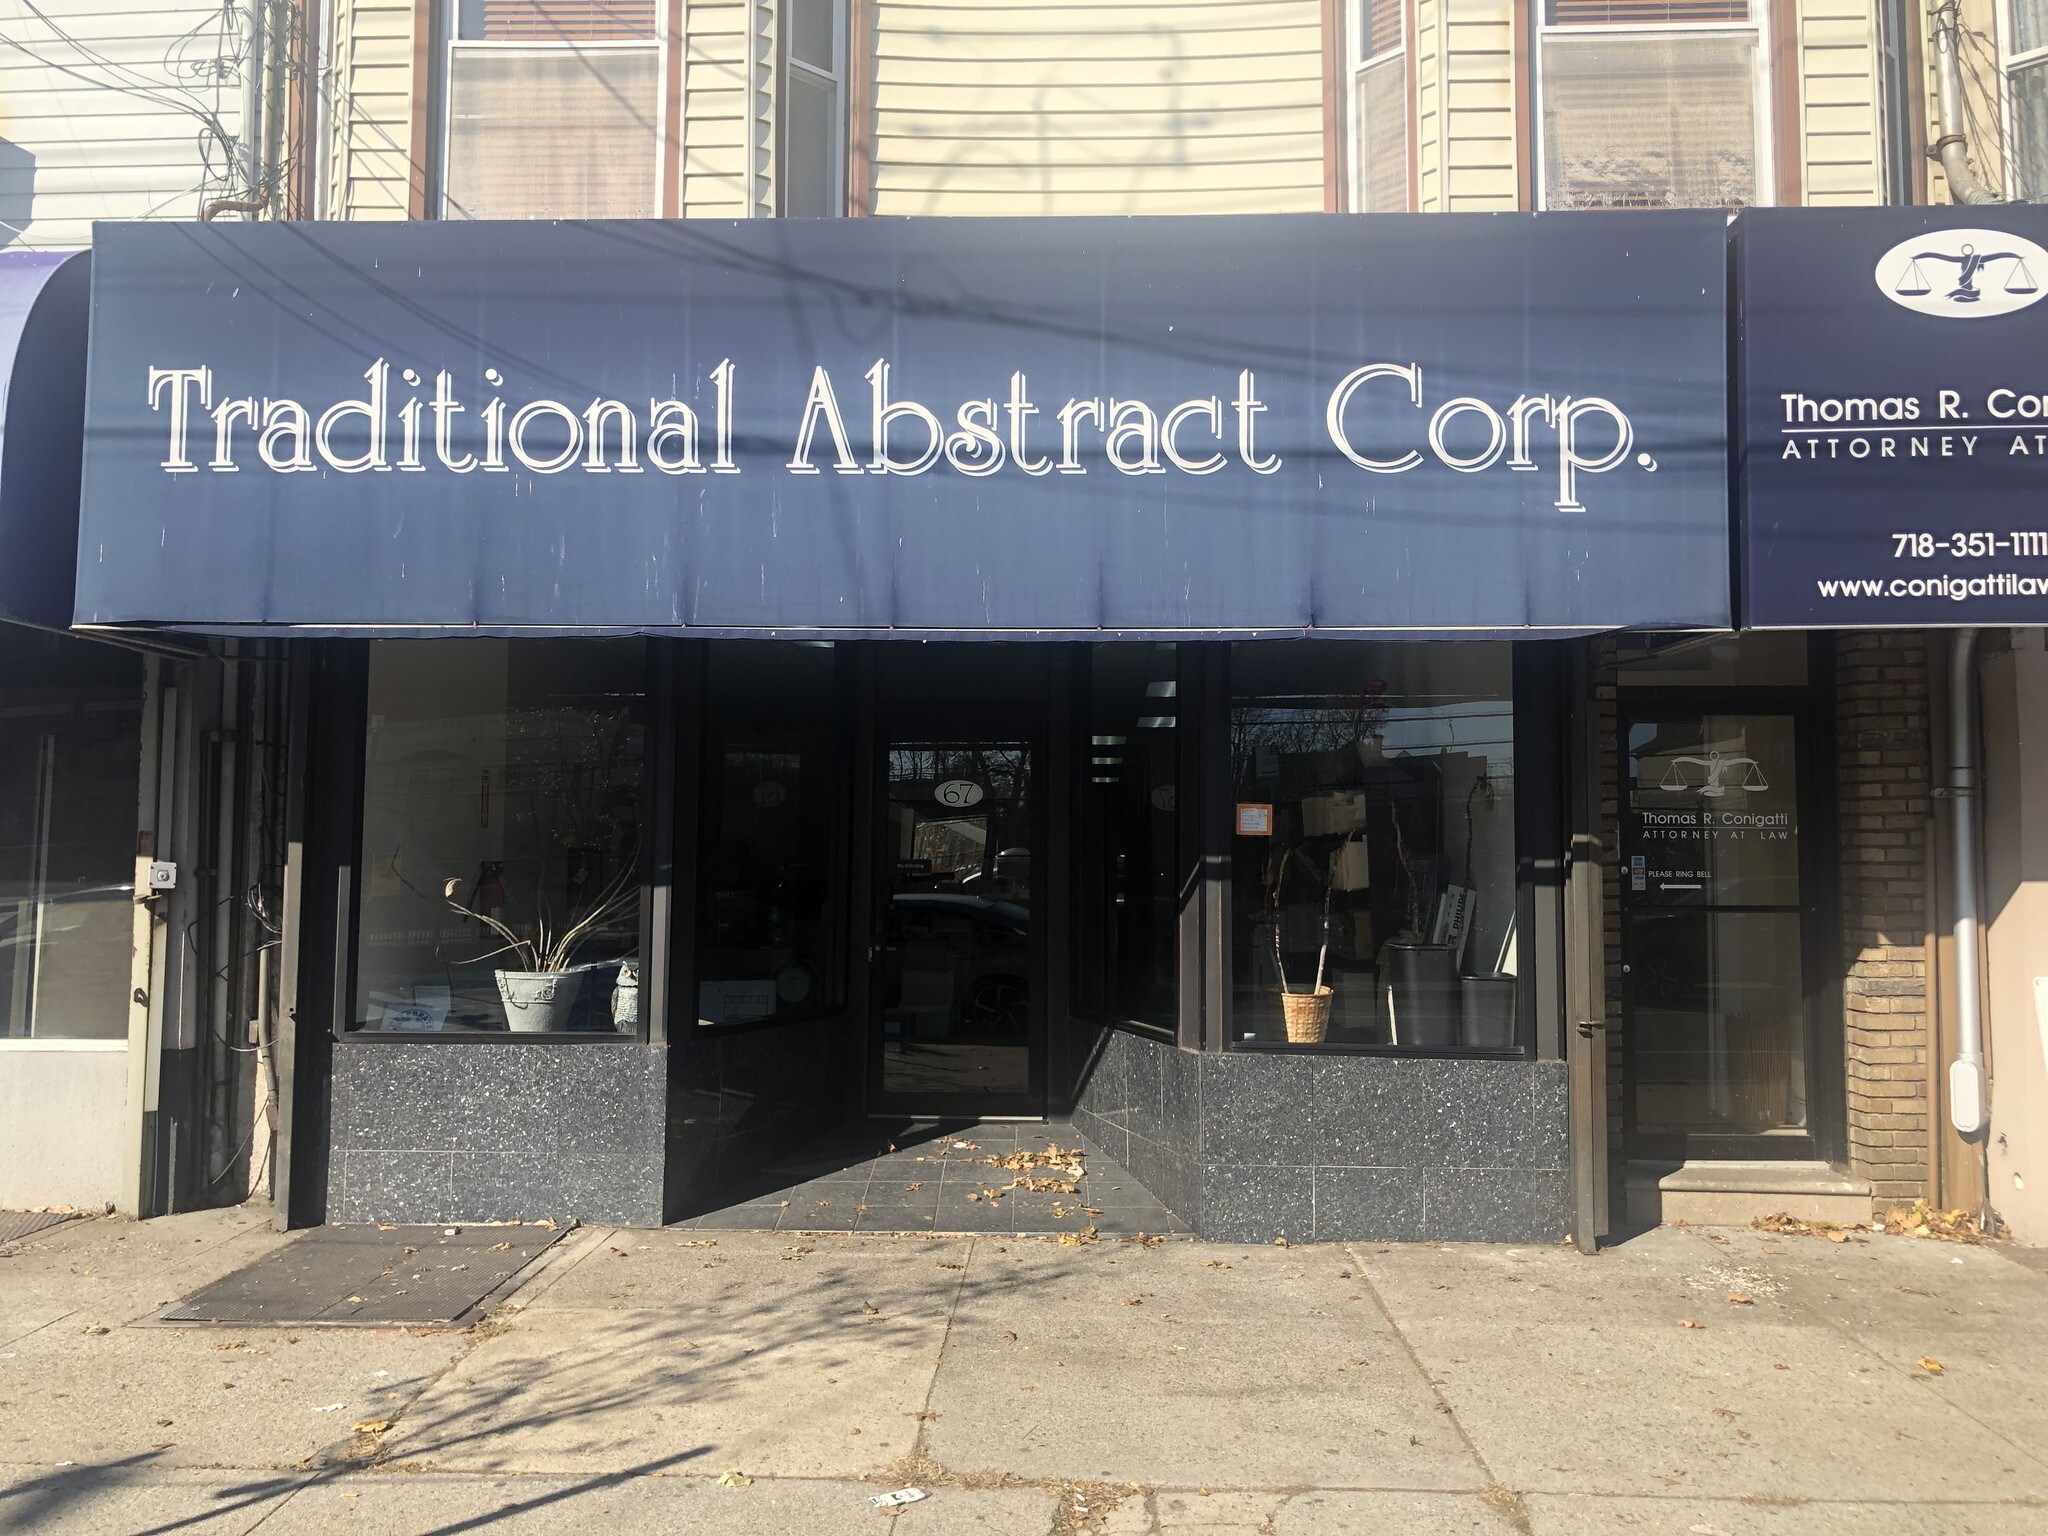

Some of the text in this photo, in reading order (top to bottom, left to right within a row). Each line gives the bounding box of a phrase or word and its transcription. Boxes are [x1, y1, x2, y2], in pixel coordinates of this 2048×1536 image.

[1780, 393, 1920, 422] Thomas
[1939, 389, 1969, 419] R.
[148, 357, 1658, 512] Traditional Abstract Corp.
[1781, 435, 2047, 459] ATTORNEY AT
[1892, 532, 2048, 558] 718-351-1111
[943, 783, 975, 804] 67
[1642, 812, 1788, 828] Thomas R. Conigatti
[1642, 830, 1788, 840] ATTORNEY AT LAW
[1648, 870, 1673, 878] PLEASE
